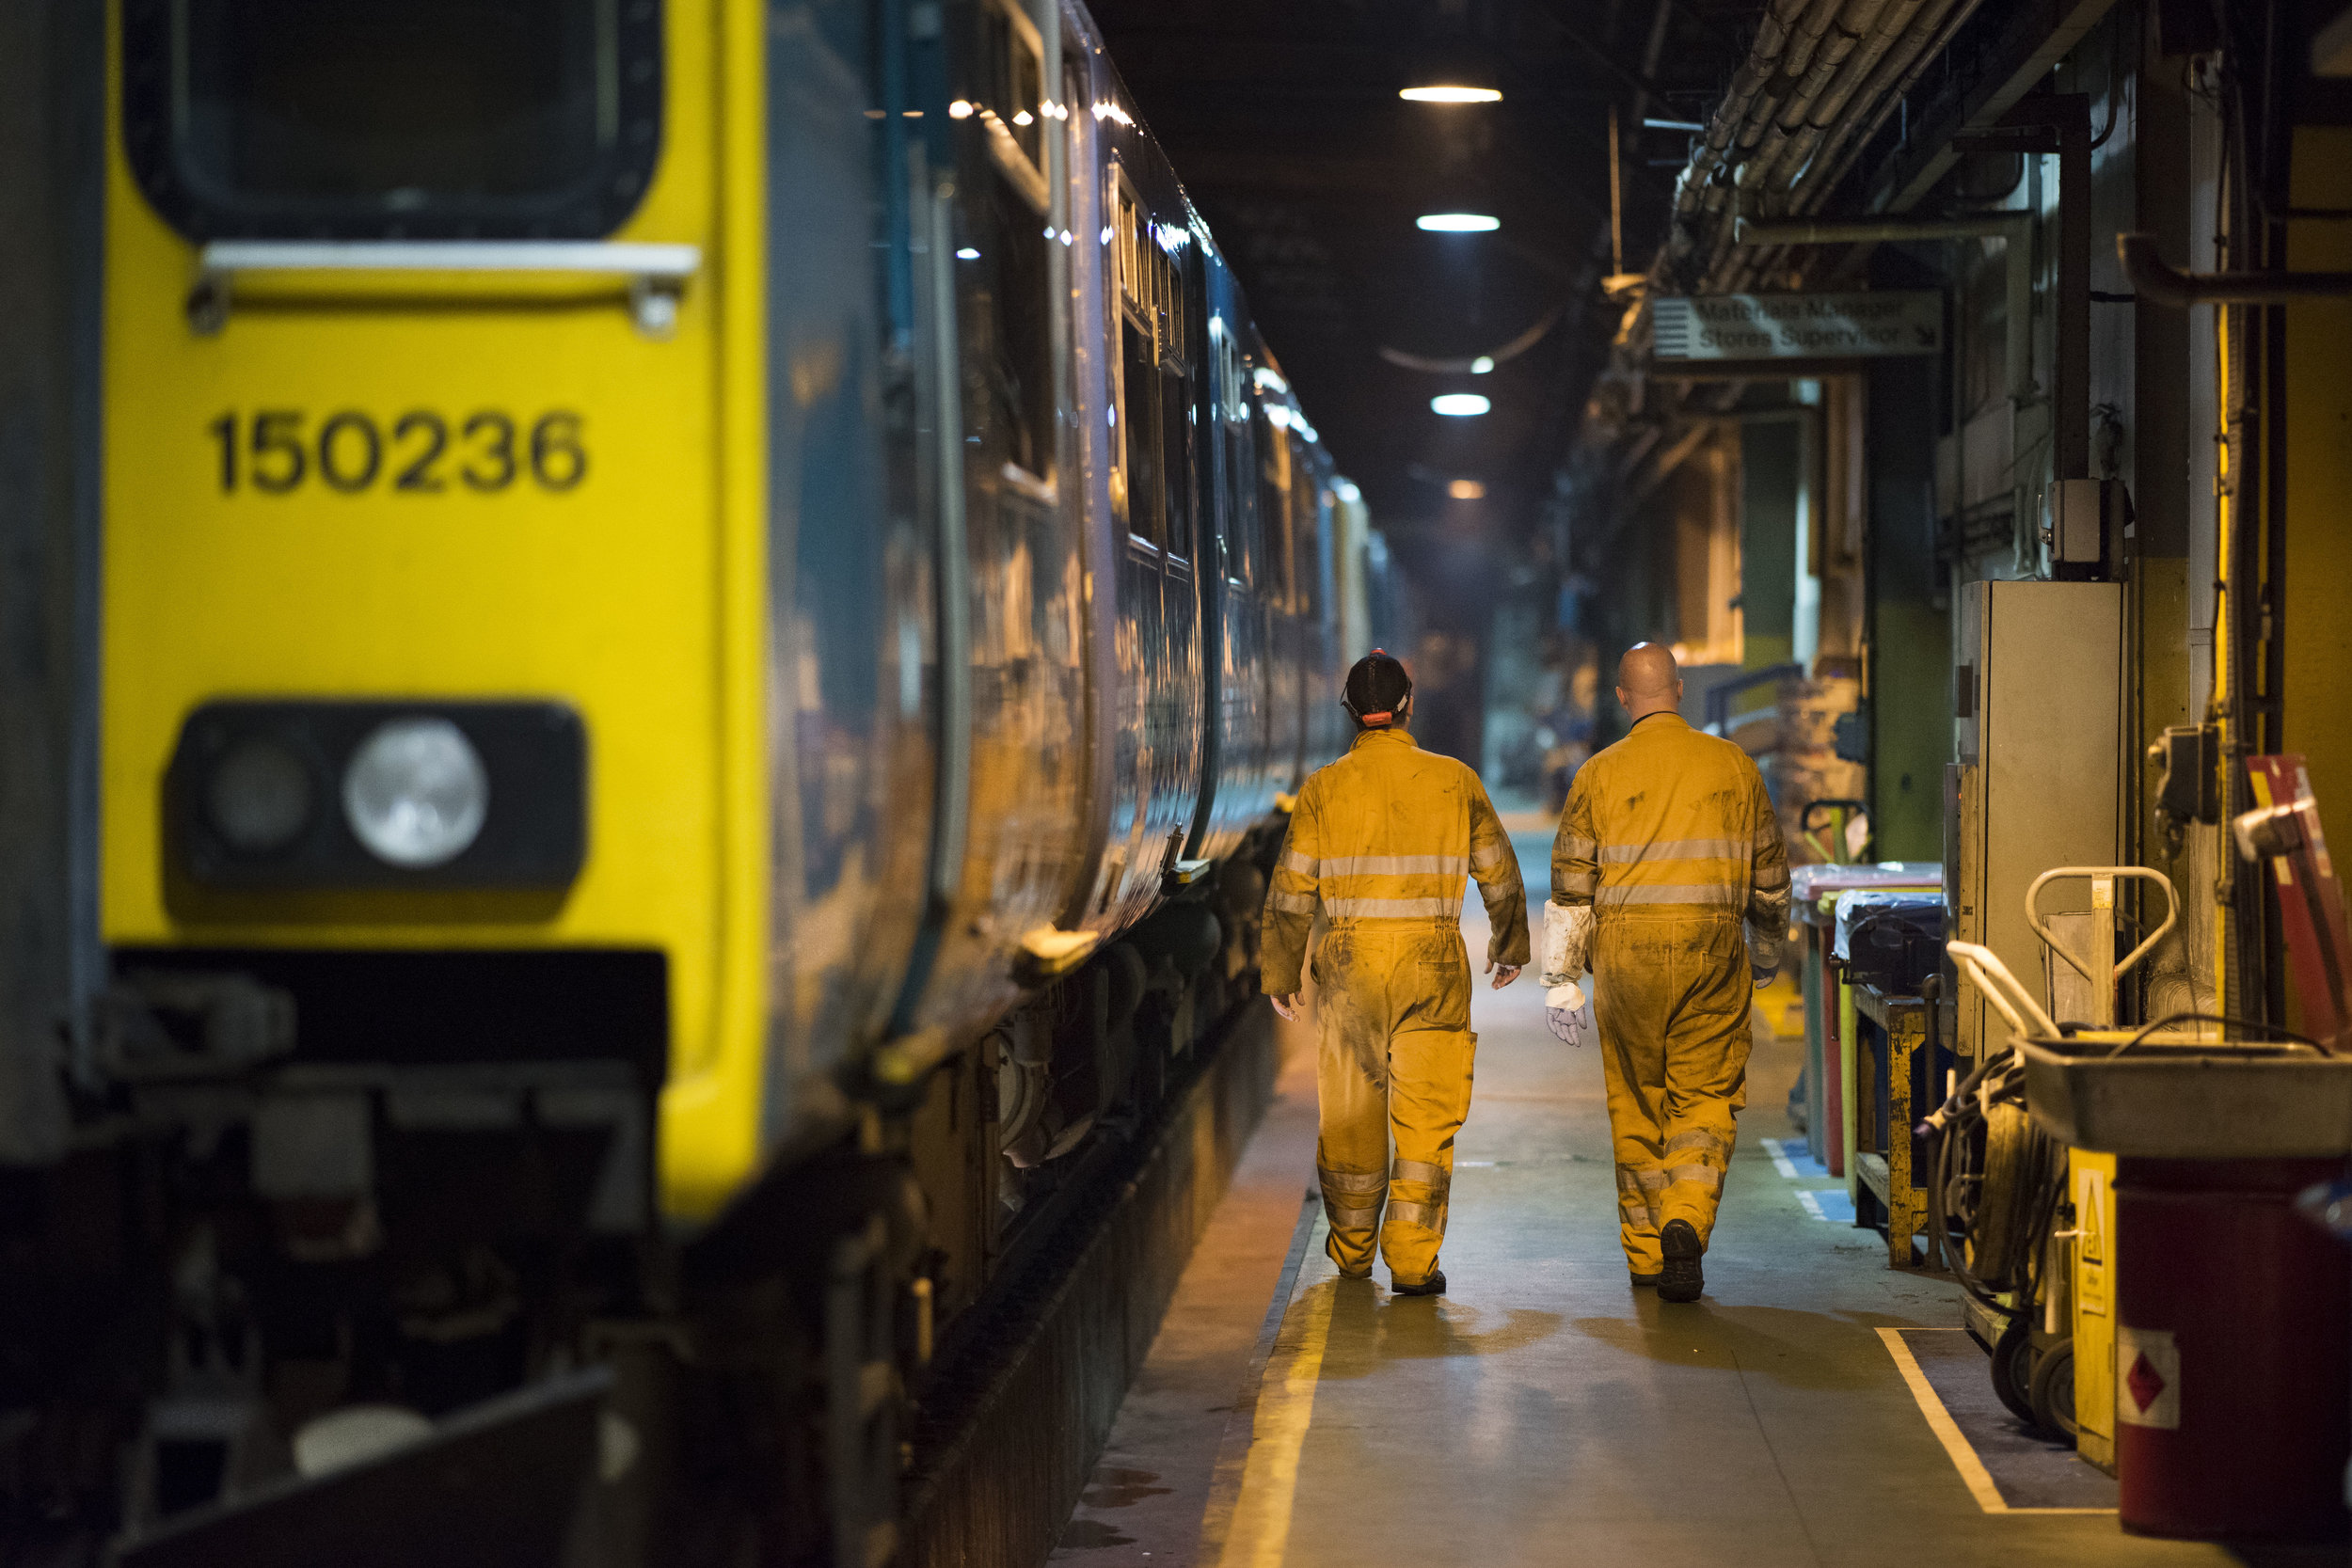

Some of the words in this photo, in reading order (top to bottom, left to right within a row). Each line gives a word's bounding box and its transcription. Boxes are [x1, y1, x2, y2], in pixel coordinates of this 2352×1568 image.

[1696, 301, 1800, 322] Materials
[1807, 299, 1905, 322] Manager
[1699, 326, 1772, 349] Stores
[1780, 325, 1900, 349] Supervisor
[210, 409, 587, 495] 150236
